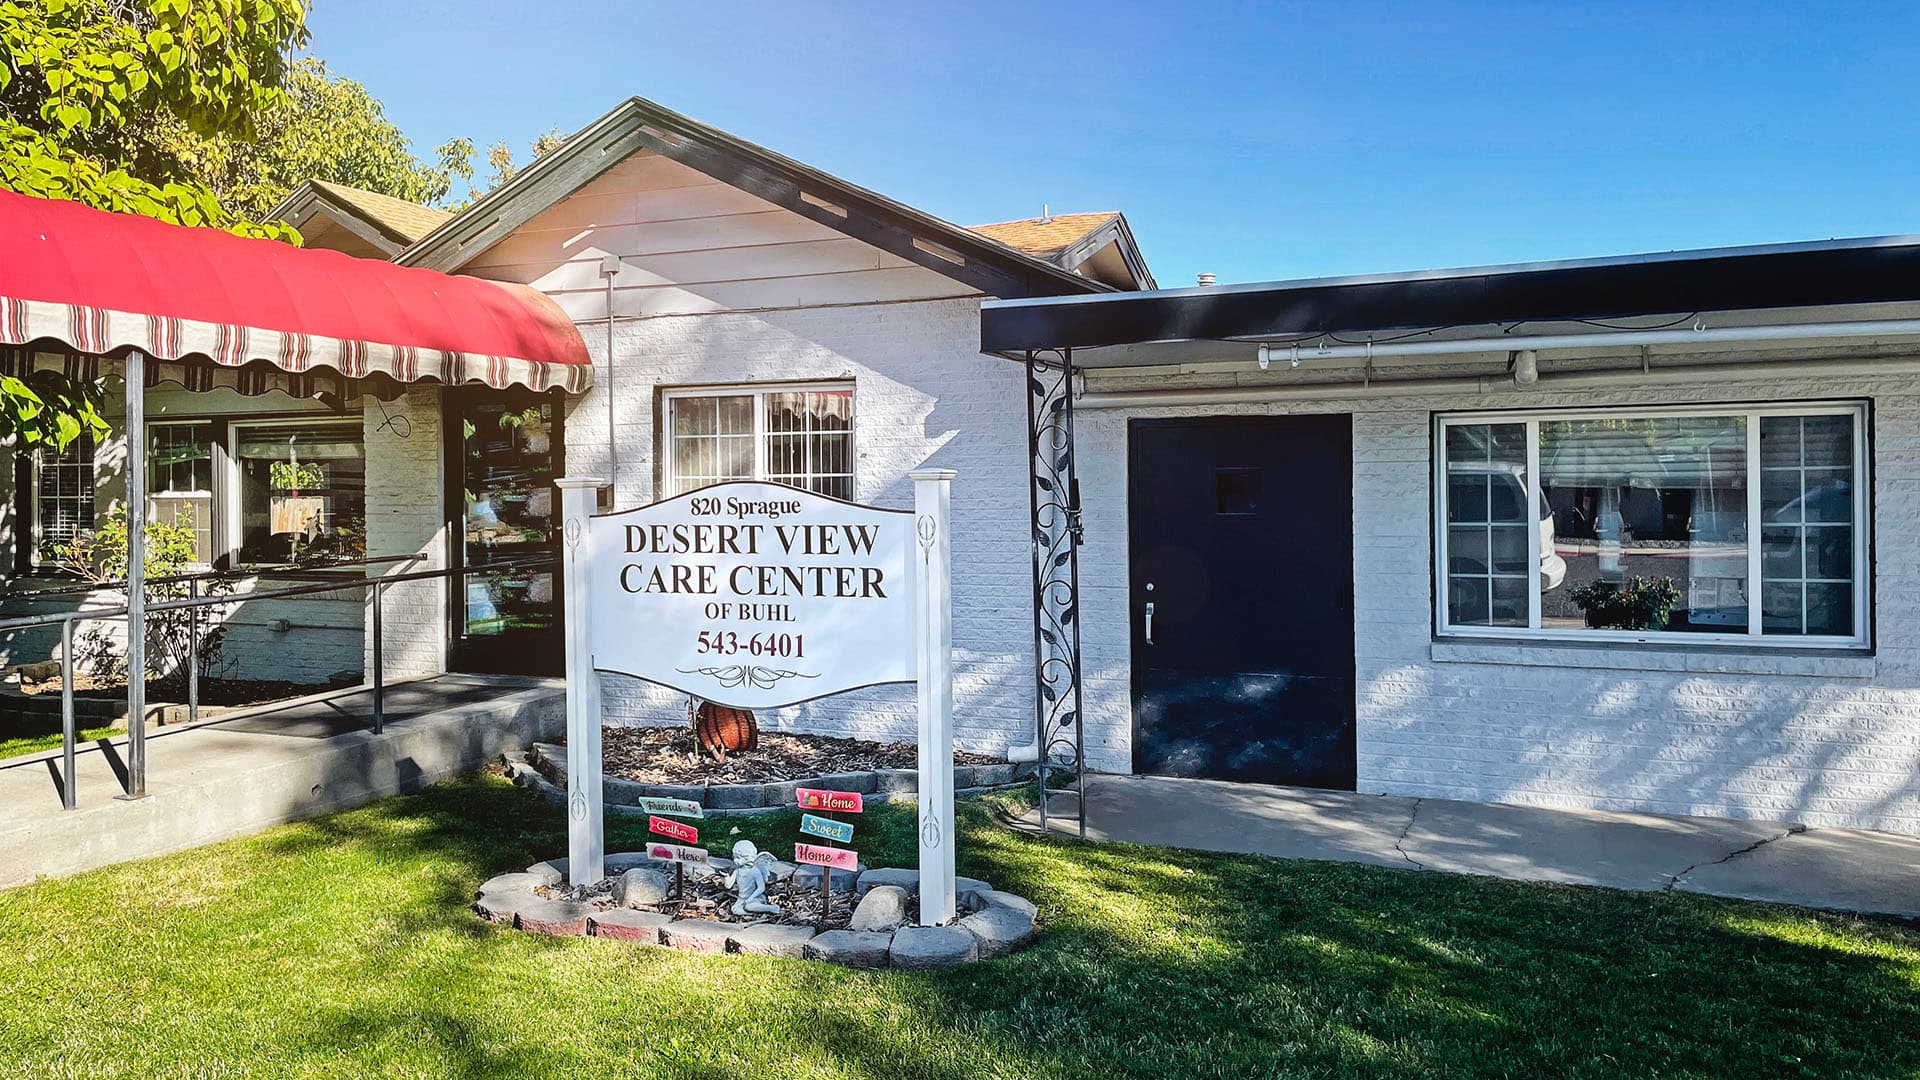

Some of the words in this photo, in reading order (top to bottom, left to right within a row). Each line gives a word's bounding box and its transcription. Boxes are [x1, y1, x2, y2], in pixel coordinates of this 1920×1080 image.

[690, 497, 721, 516] 820
[726, 497, 801, 520] Sprague
[624, 524, 763, 555] DESERT
[774, 524, 881, 556] VIEW
[619, 563, 718, 595] CARE
[729, 565, 888, 599] CENTER
[704, 602, 732, 621] OF
[739, 603, 797, 622] BUHL
[697, 631, 805, 658] 543-6401
[646, 800, 682, 812] Friends
[821, 793, 856, 809] Home
[656, 821, 689, 839] Gather
[808, 819, 842, 838] Sweet
[676, 849, 702, 862] Here
[798, 845, 833, 863] Home
